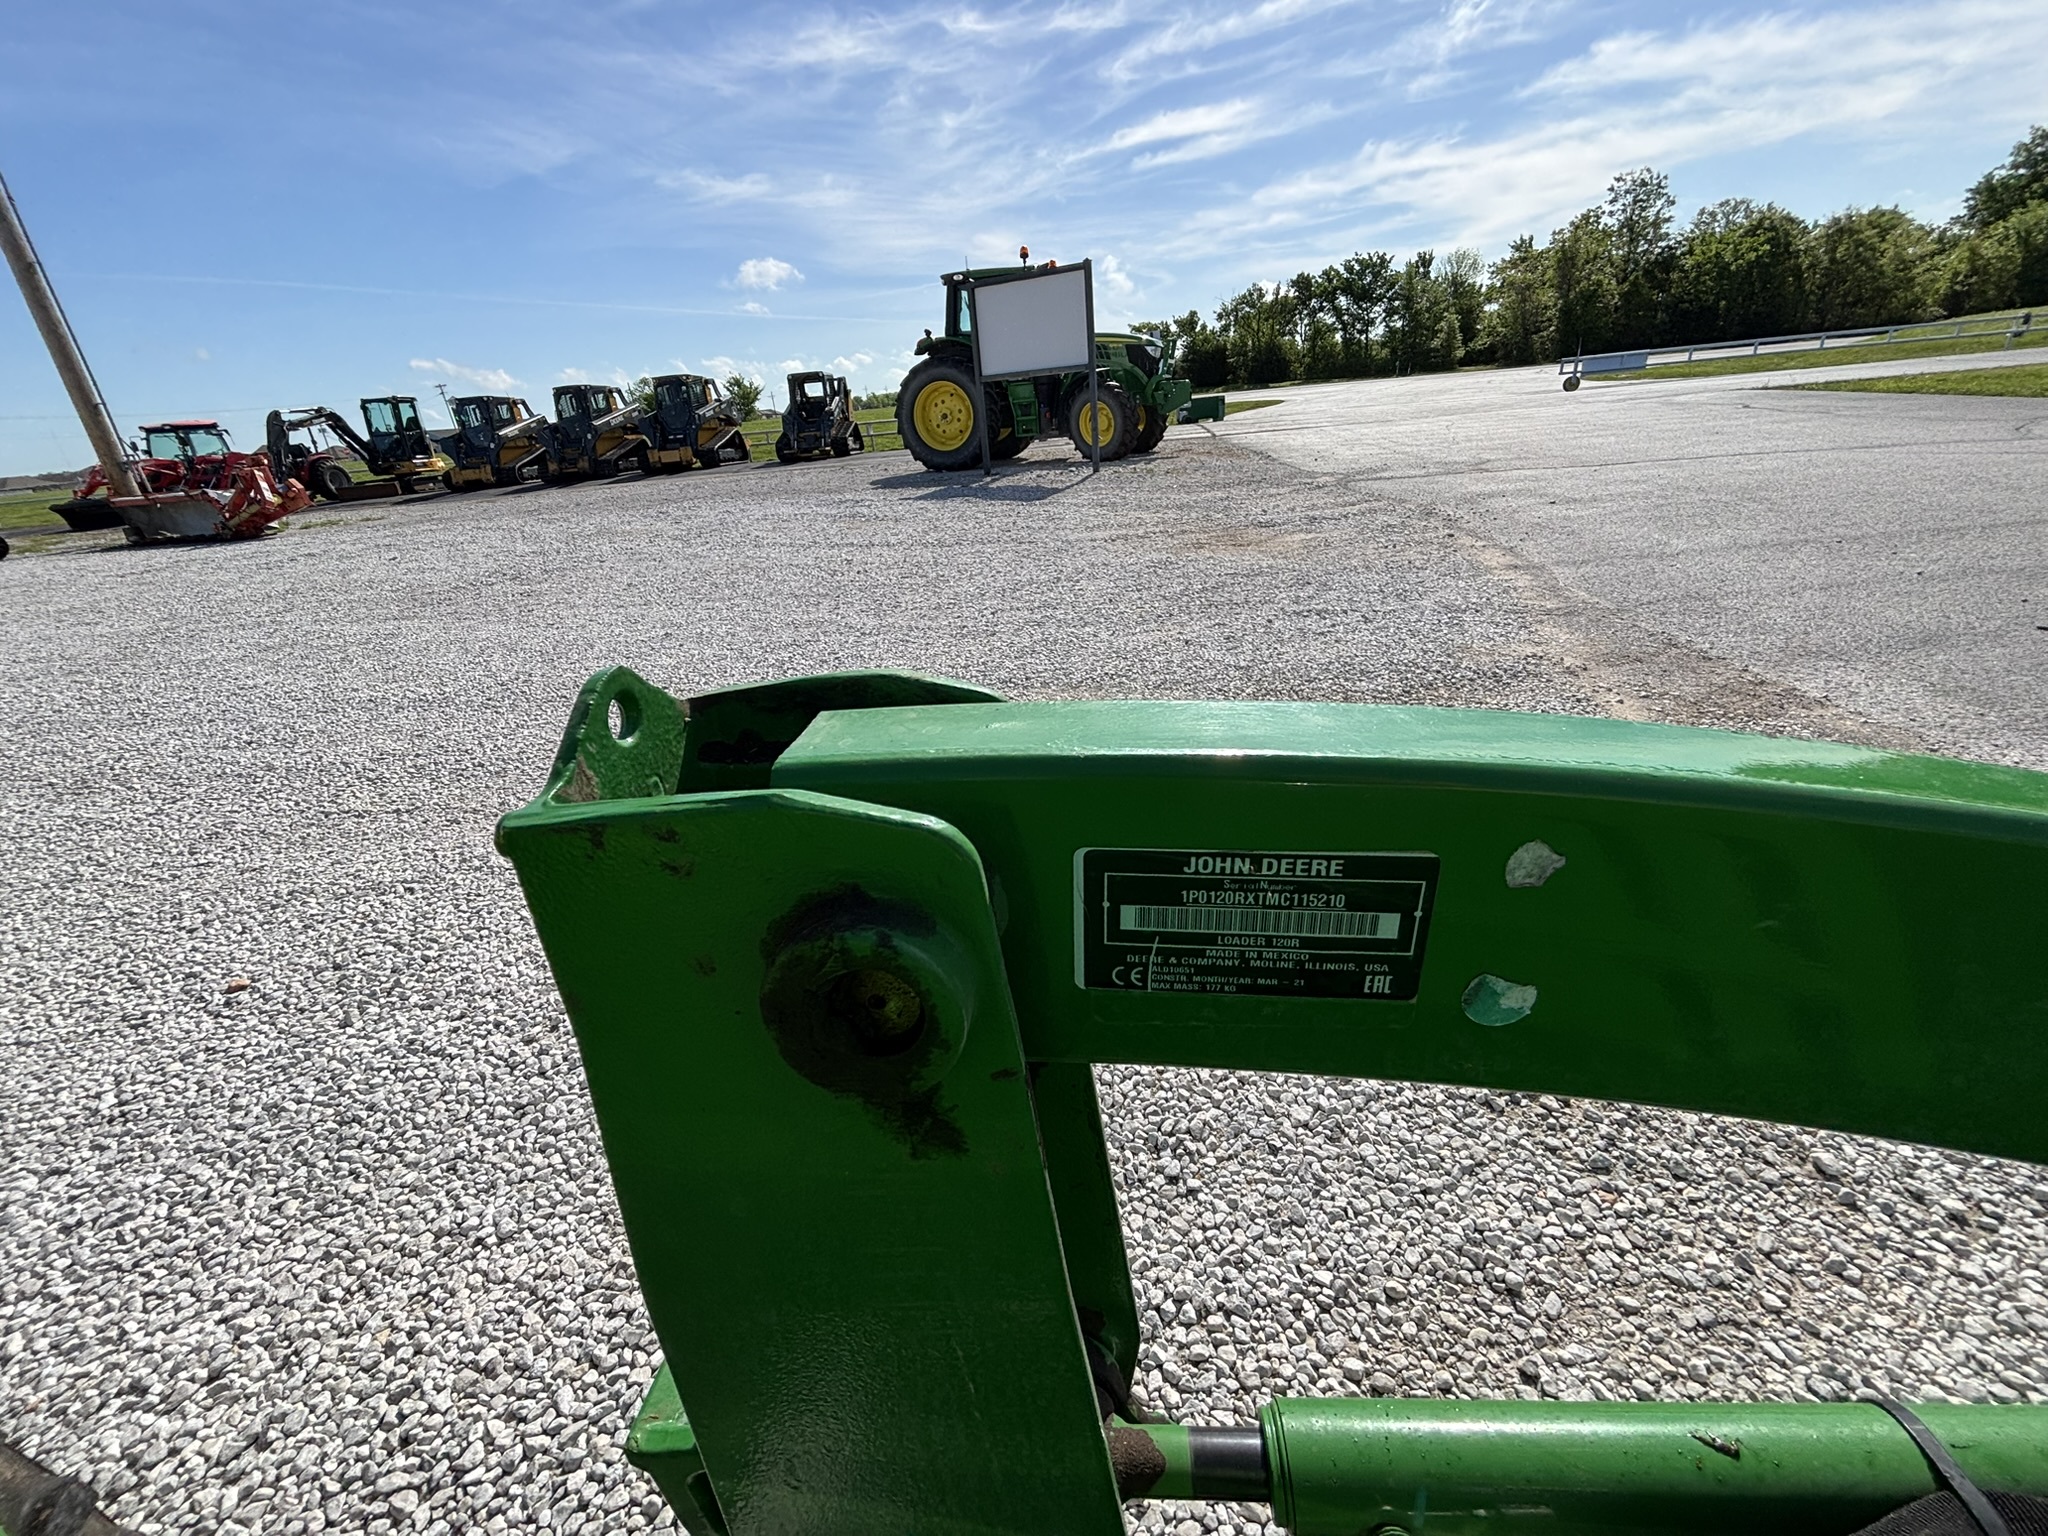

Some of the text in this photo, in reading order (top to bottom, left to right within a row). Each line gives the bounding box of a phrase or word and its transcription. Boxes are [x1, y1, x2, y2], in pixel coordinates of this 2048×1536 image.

[1183, 856, 1345, 877] JOHN DEERE
[1181, 890, 1346, 908] 1P0120RXTMC115210
[1217, 935, 1300, 947] LOADER 120R
[1206, 949, 1310, 961] MADE IN MEXICO
[1126, 954, 1165, 964] DEERE
[1168, 956, 1177, 964] &
[1364, 963, 1389, 972] USA
[1173, 983, 1202, 991] MASS:
[1257, 977, 1278, 985] MAR
[1293, 979, 1305, 987] 21
